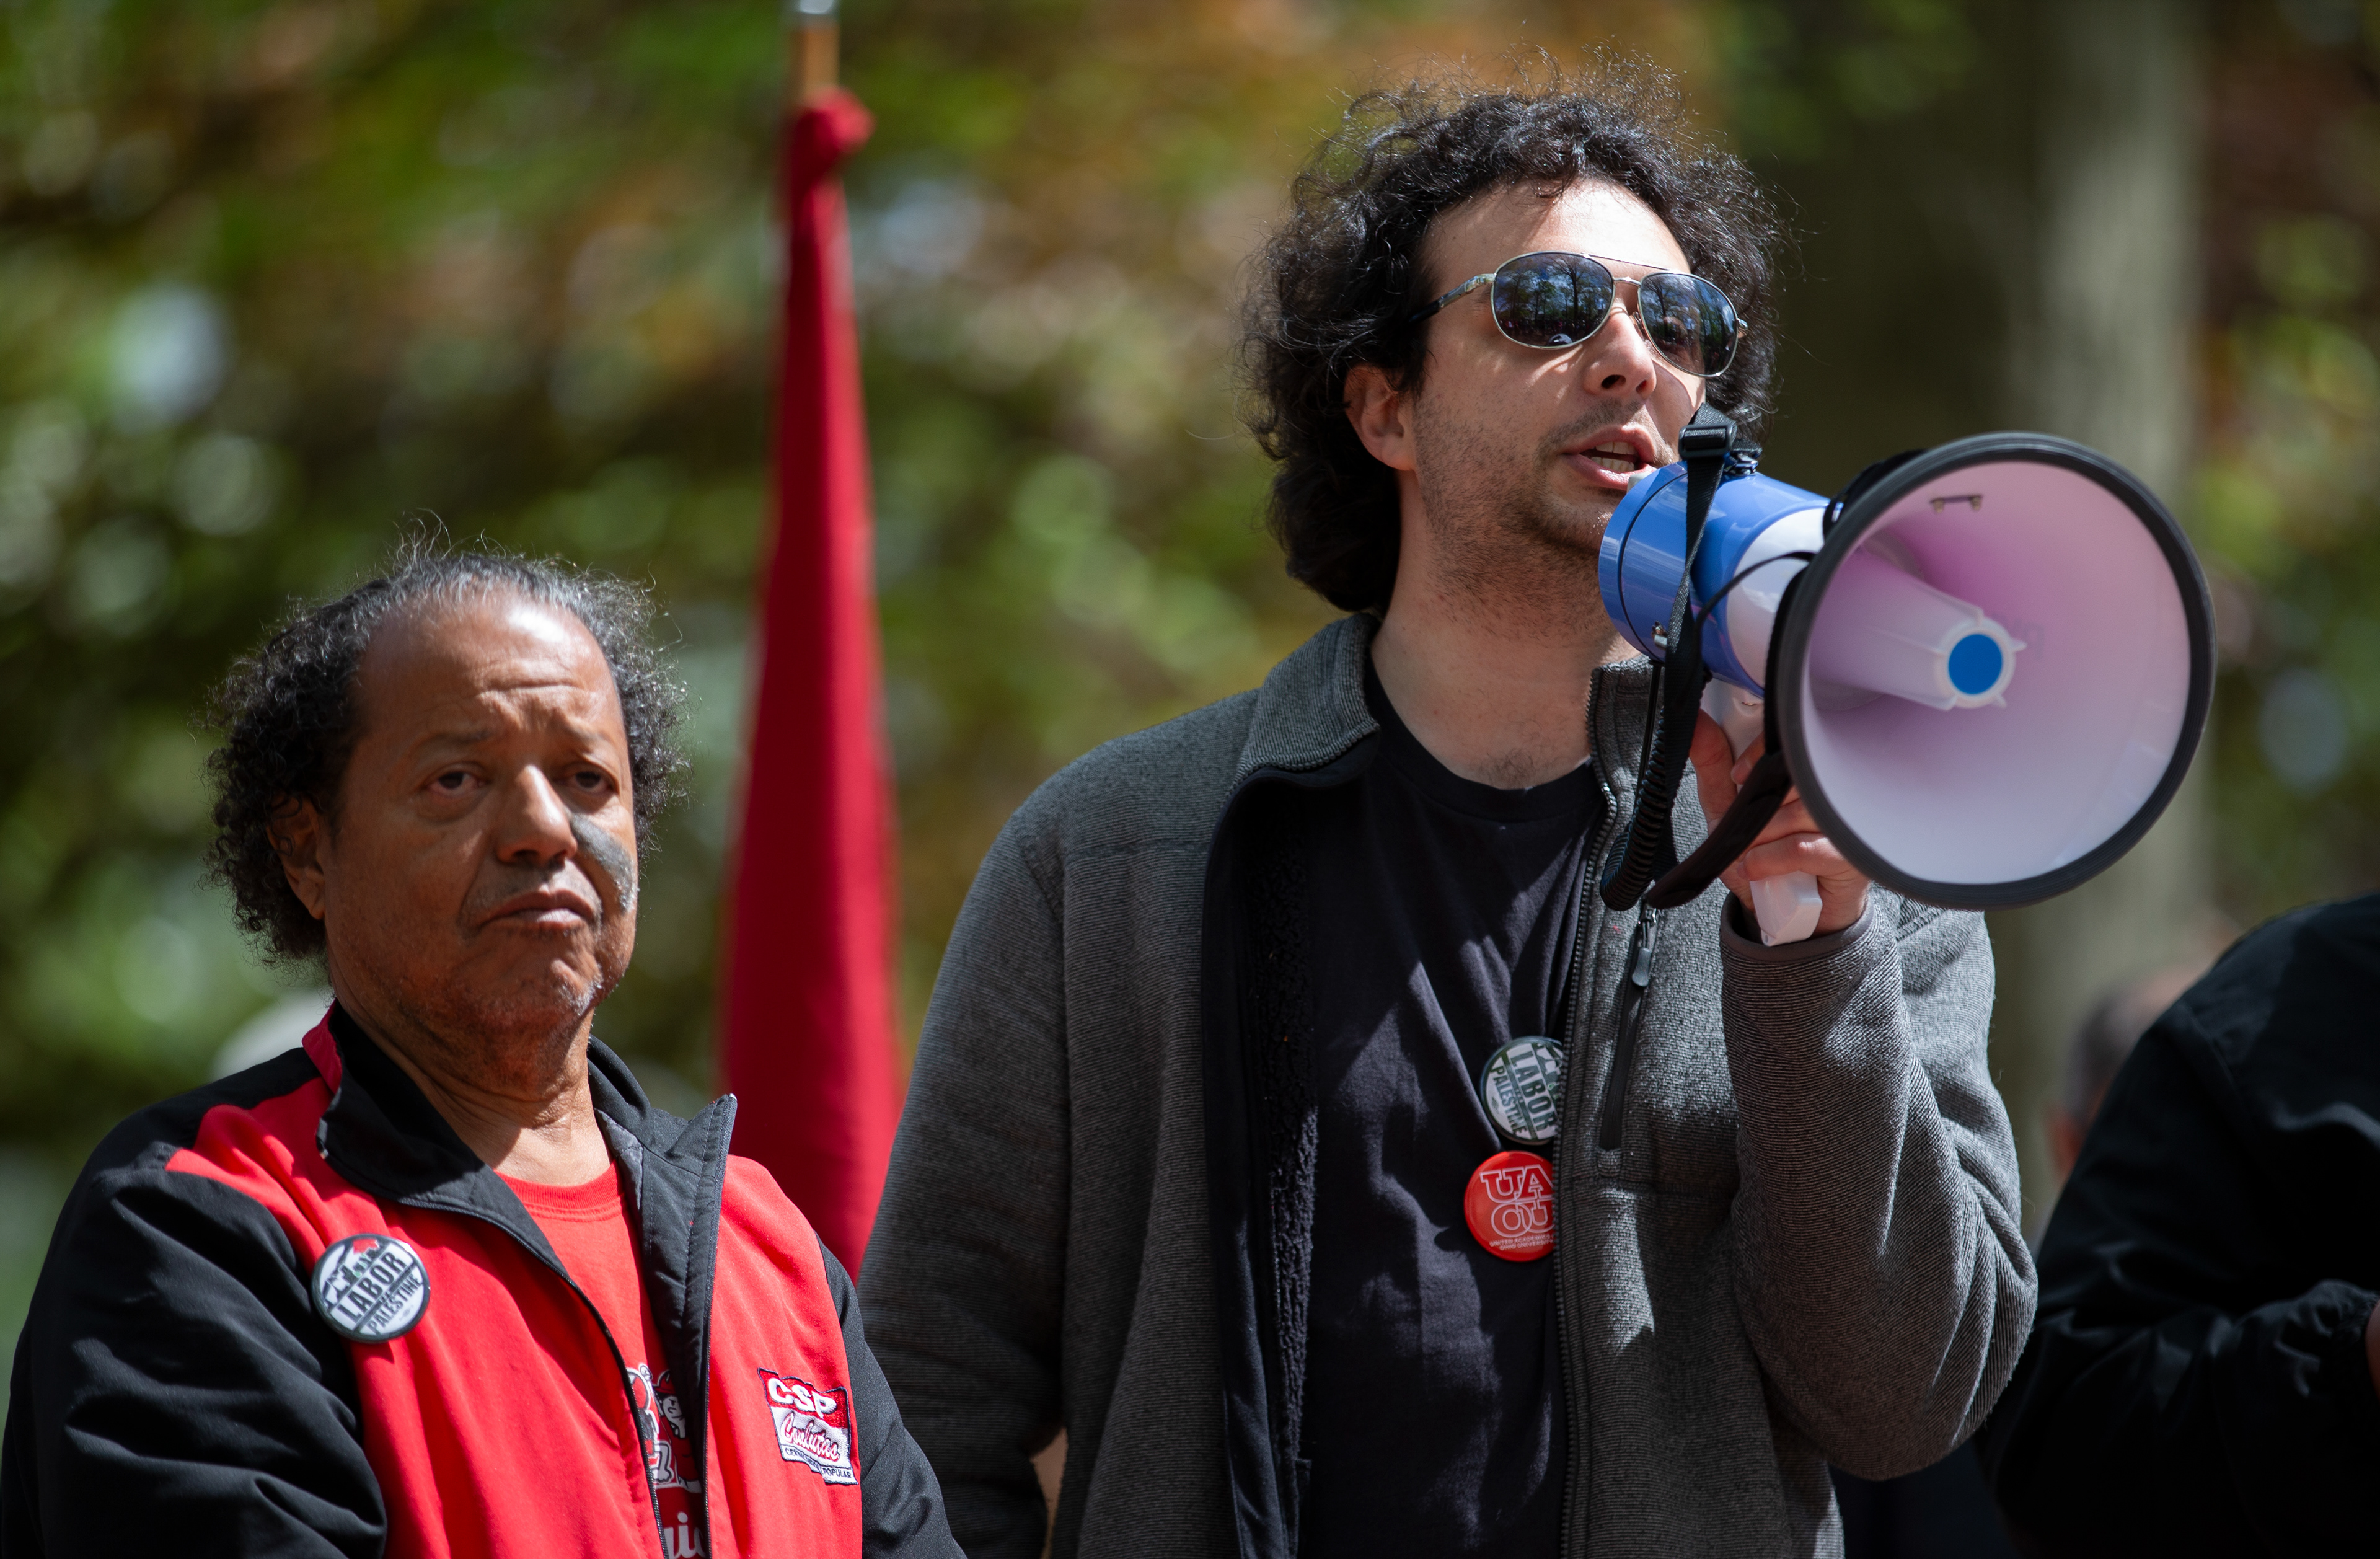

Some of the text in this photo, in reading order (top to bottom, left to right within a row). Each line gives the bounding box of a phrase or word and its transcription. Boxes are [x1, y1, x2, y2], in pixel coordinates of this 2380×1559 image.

[1490, 1065, 1527, 1137] PALESTINE
[1510, 1050, 1558, 1132] LABOR
[1499, 1242, 1517, 1251] OHIO
[337, 1252, 407, 1319] LABOR
[366, 1274, 423, 1335] PALESTINE
[768, 1377, 837, 1419] CSP
